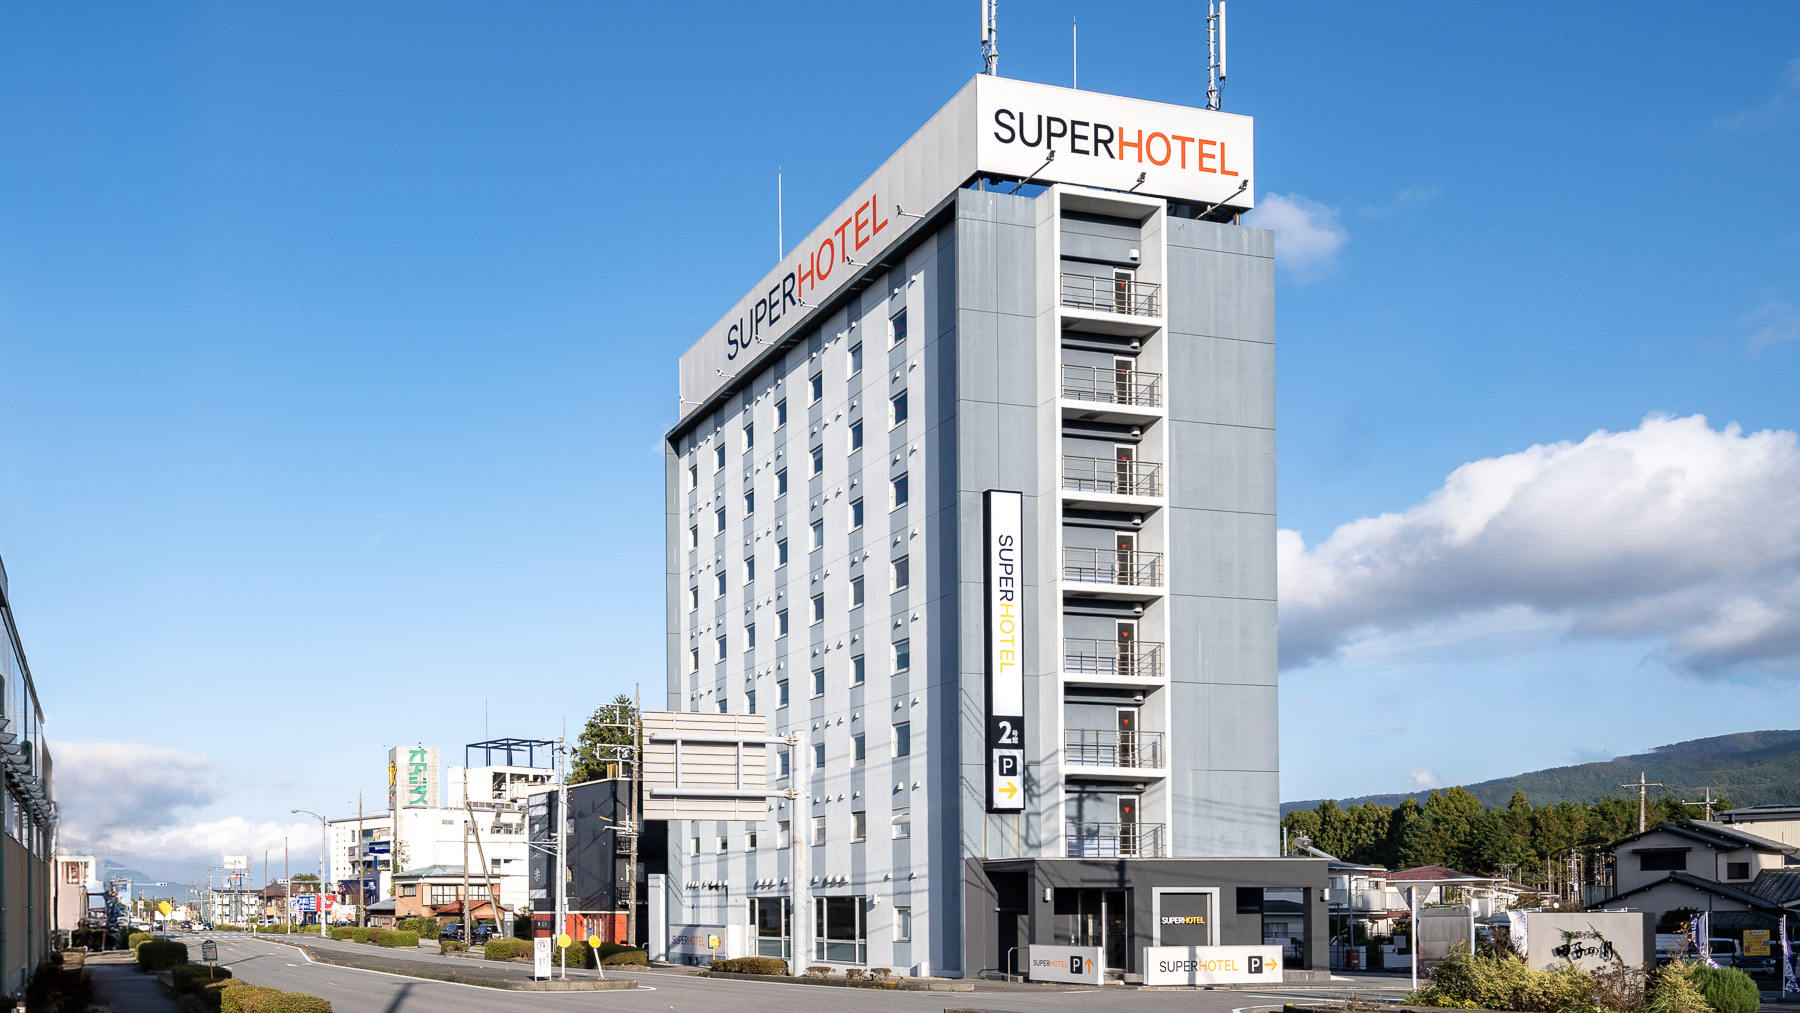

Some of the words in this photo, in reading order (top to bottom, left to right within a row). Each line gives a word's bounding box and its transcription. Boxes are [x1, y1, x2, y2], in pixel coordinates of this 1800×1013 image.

[993, 108, 1239, 177] SUPERHOTEL
[727, 194, 888, 361] SUPERHOTEL
[998, 534, 1015, 673] SUPERHOTEL
[1162, 916, 1206, 925] SUPERHOTEL
[672, 934, 706, 947] SUPERHOTEL
[1033, 959, 1068, 969] SUPERHOTEL
[1159, 959, 1239, 973] SUPERHOTEL
